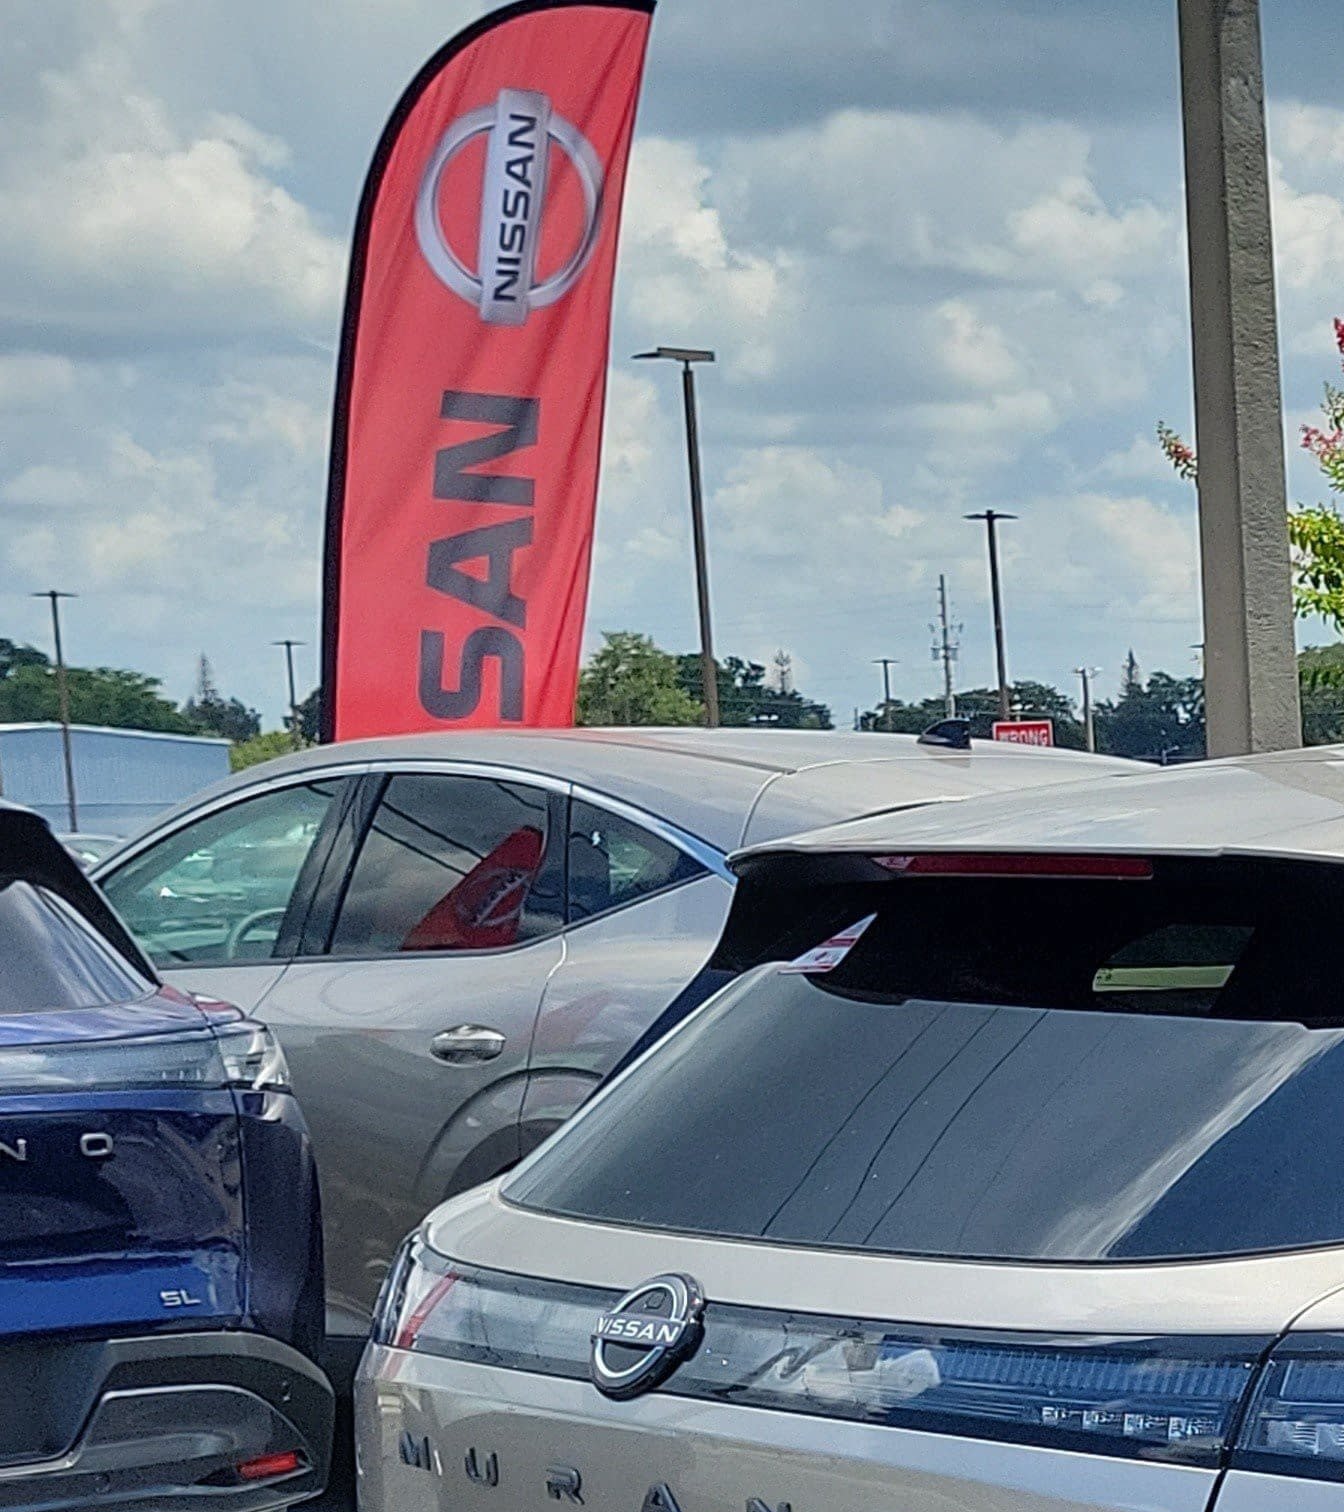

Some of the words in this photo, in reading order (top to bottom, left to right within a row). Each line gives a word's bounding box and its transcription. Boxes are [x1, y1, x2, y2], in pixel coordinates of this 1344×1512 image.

[493, 113, 537, 301] NISSAN
[160, 1290, 201, 1309] SL
[597, 1316, 680, 1343] NISSAN
